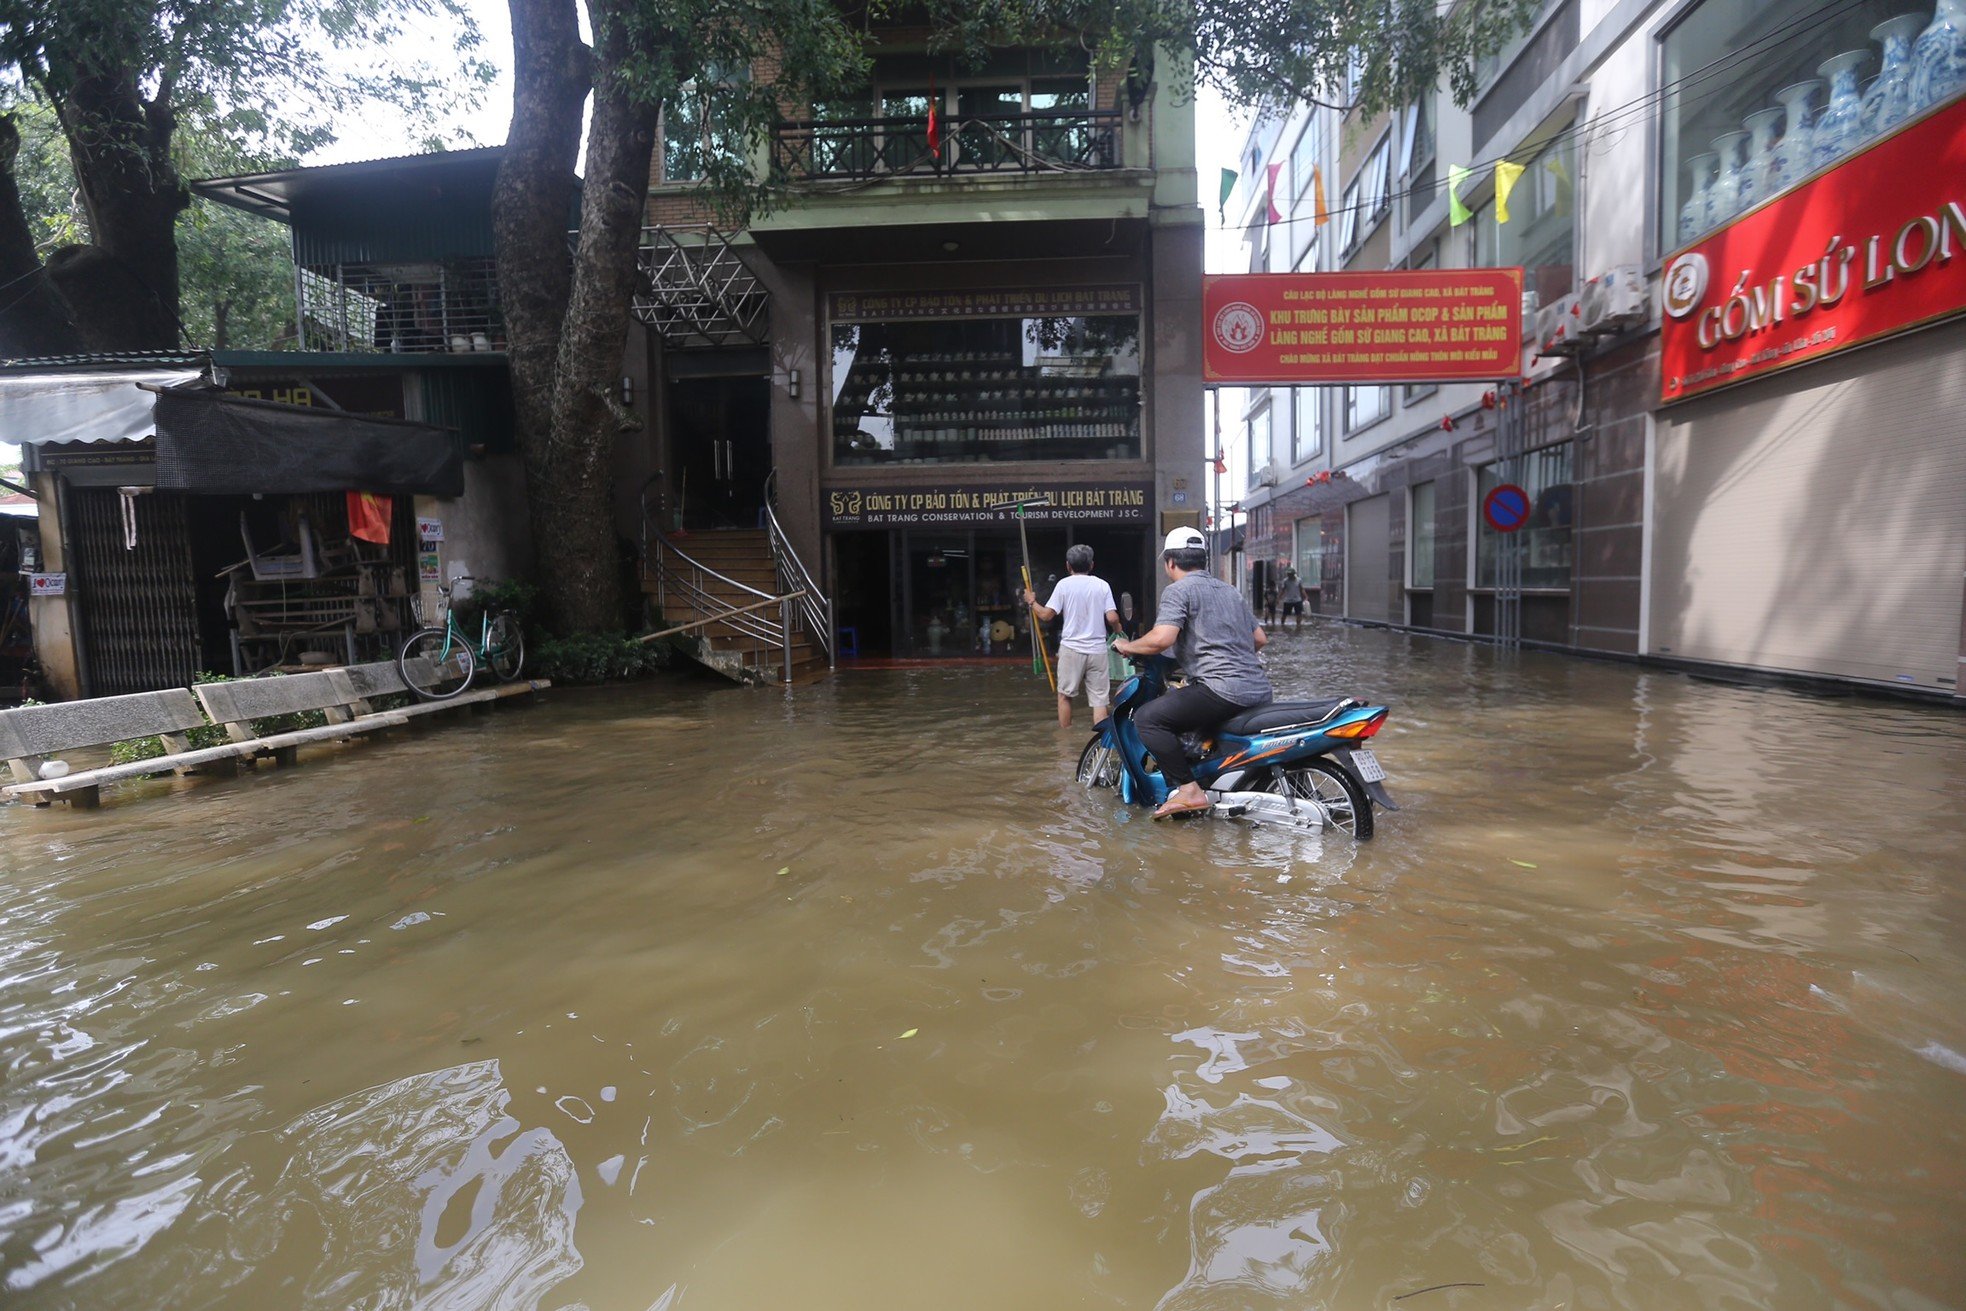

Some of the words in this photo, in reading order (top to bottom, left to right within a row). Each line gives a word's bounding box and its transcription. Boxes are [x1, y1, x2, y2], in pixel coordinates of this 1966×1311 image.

[1697, 269, 1783, 349] GỐM
[1791, 235, 1855, 315] SỨ
[1270, 310, 1290, 324] KHU
[1293, 308, 1327, 324] TRƯNG
[1331, 306, 1350, 323] BÀY
[1354, 304, 1375, 322] SẢN
[1378, 302, 1408, 322] PHẨM
[1411, 307, 1439, 322] OCOP
[1441, 307, 1450, 321] &
[1452, 303, 1474, 321] SẢN
[1476, 300, 1507, 320] PHẨM
[1270, 328, 1298, 345] LÀNG
[1300, 325, 1328, 345] NGHỀ
[1331, 326, 1354, 344] GỐM
[1357, 327, 1372, 344] SỨ
[1374, 328, 1406, 343] GIANG
[1434, 325, 1449, 342] XÃ
[1451, 325, 1471, 342] BÁT
[1472, 323, 1507, 341] TRÀNG
[866, 492, 892, 511] CÔNG
[894, 493, 908, 510] TY
[911, 492, 923, 509] CP
[925, 489, 946, 509] BẢO
[949, 488, 970, 509] TỒN
[972, 493, 980, 508] &
[1061, 489, 1083, 509] LỊCH
[1086, 487, 1105, 506] BÁT
[1108, 486, 1144, 506] TRÀNG
[1175, 494, 1184, 502] 68
[867, 513, 885, 523] BAT
[887, 513, 918, 522] TRANG
[922, 511, 994, 522] CONSERVATION
[998, 512, 1005, 520] &
[1010, 510, 1049, 520] TOURISM
[1051, 509, 1114, 519] DEVELOPMENT
